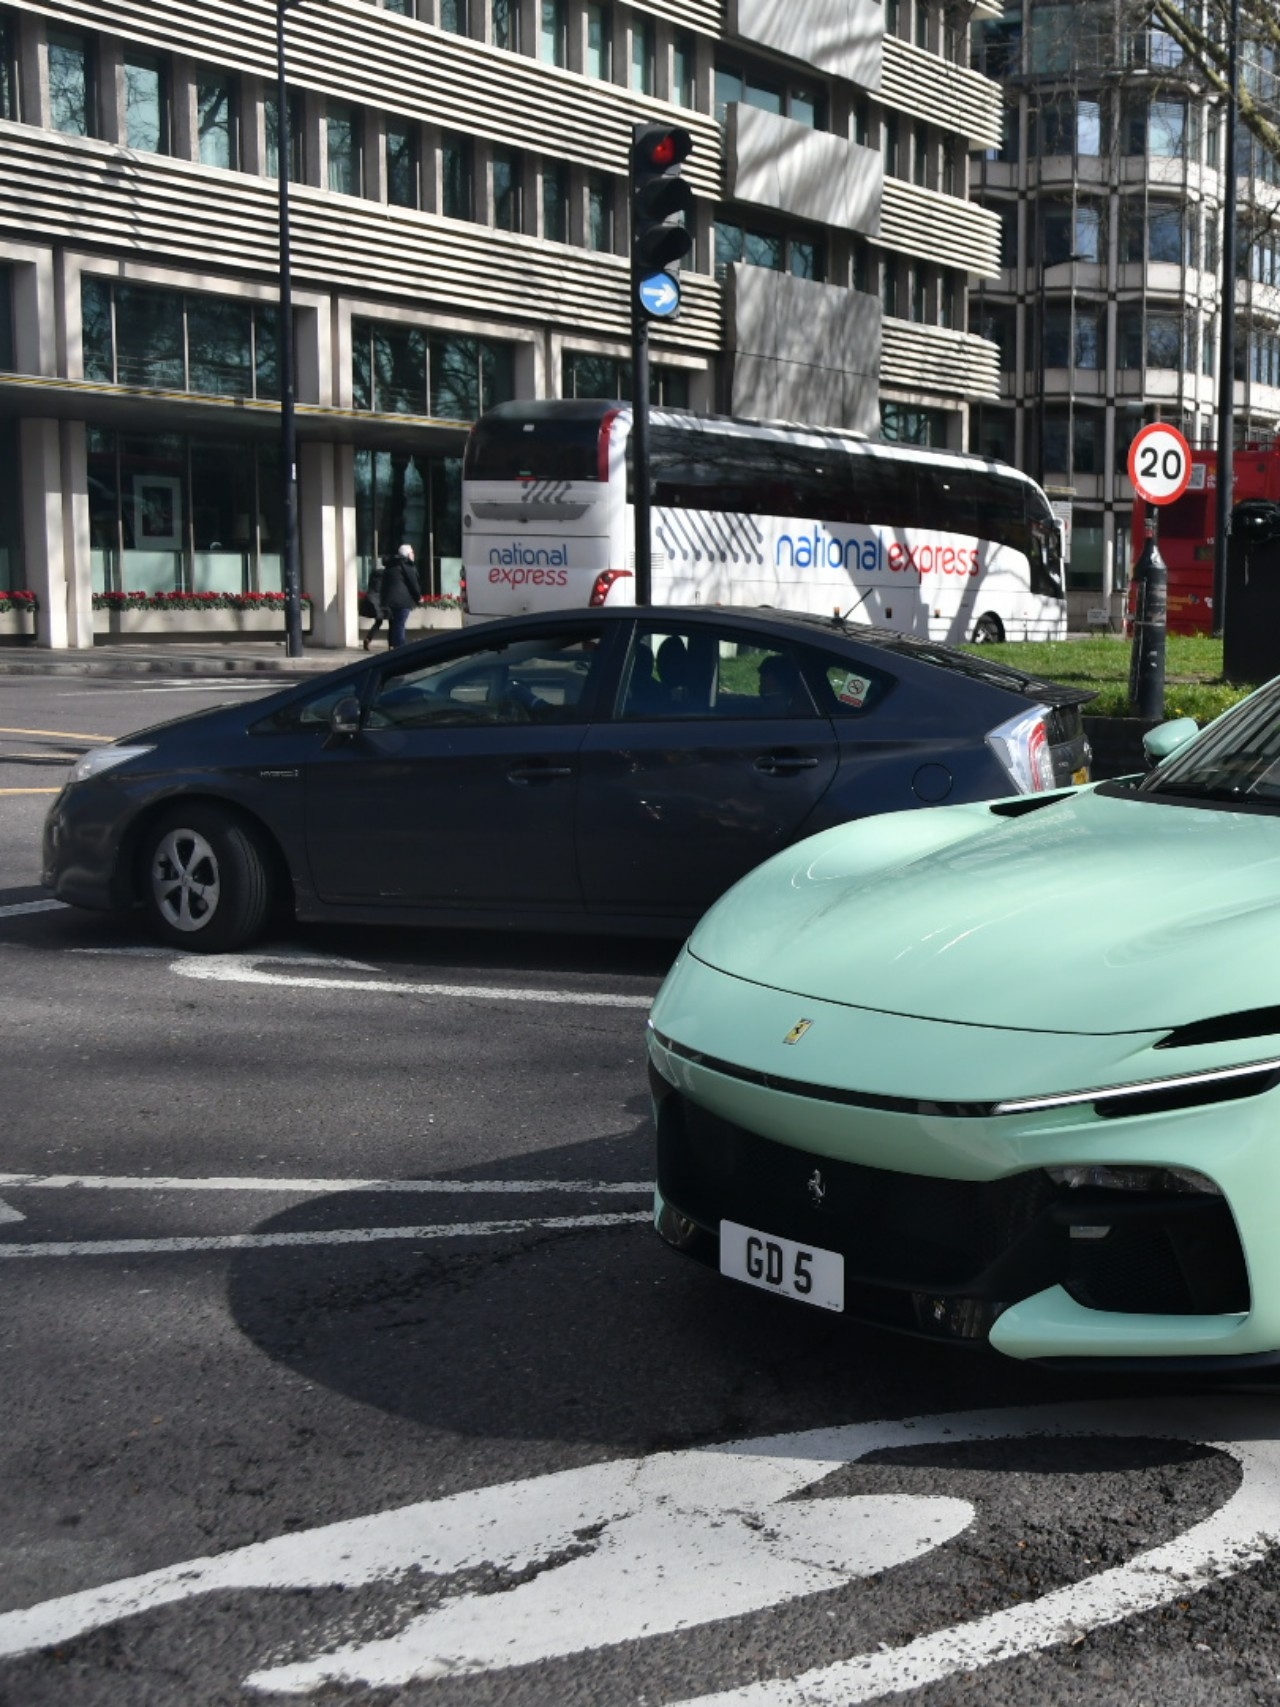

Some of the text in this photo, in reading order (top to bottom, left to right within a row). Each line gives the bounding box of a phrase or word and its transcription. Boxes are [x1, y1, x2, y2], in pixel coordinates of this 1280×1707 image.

[1140, 447, 1181, 480] 20
[489, 542, 568, 566] national
[776, 525, 979, 584] national express
[489, 568, 568, 590] express
[747, 1236, 812, 1294] GD 5
